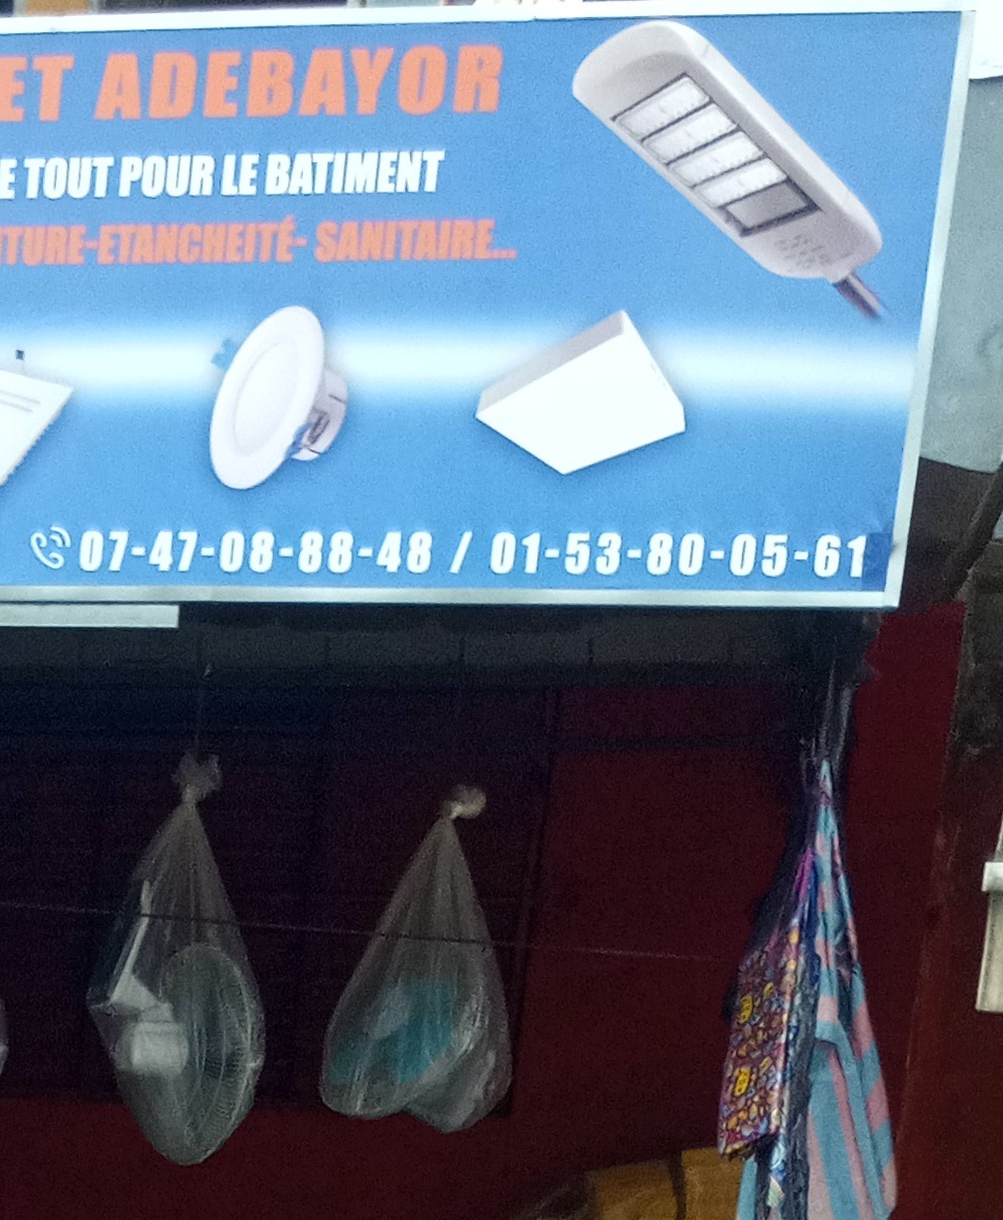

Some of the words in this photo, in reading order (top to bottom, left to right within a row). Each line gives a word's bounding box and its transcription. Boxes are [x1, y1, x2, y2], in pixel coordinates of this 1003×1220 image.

[93, 44, 505, 121] ADEBAYOR
[23, 156, 113, 200] TOUT
[118, 154, 216, 198] POUR
[221, 153, 260, 196] LE
[263, 150, 446, 196] BATIMENT
[79, 530, 432, 574] 07-47-08-88-48
[449, 530, 473, 574] /
[489, 531, 868, 578] 01-53-80-05-61
